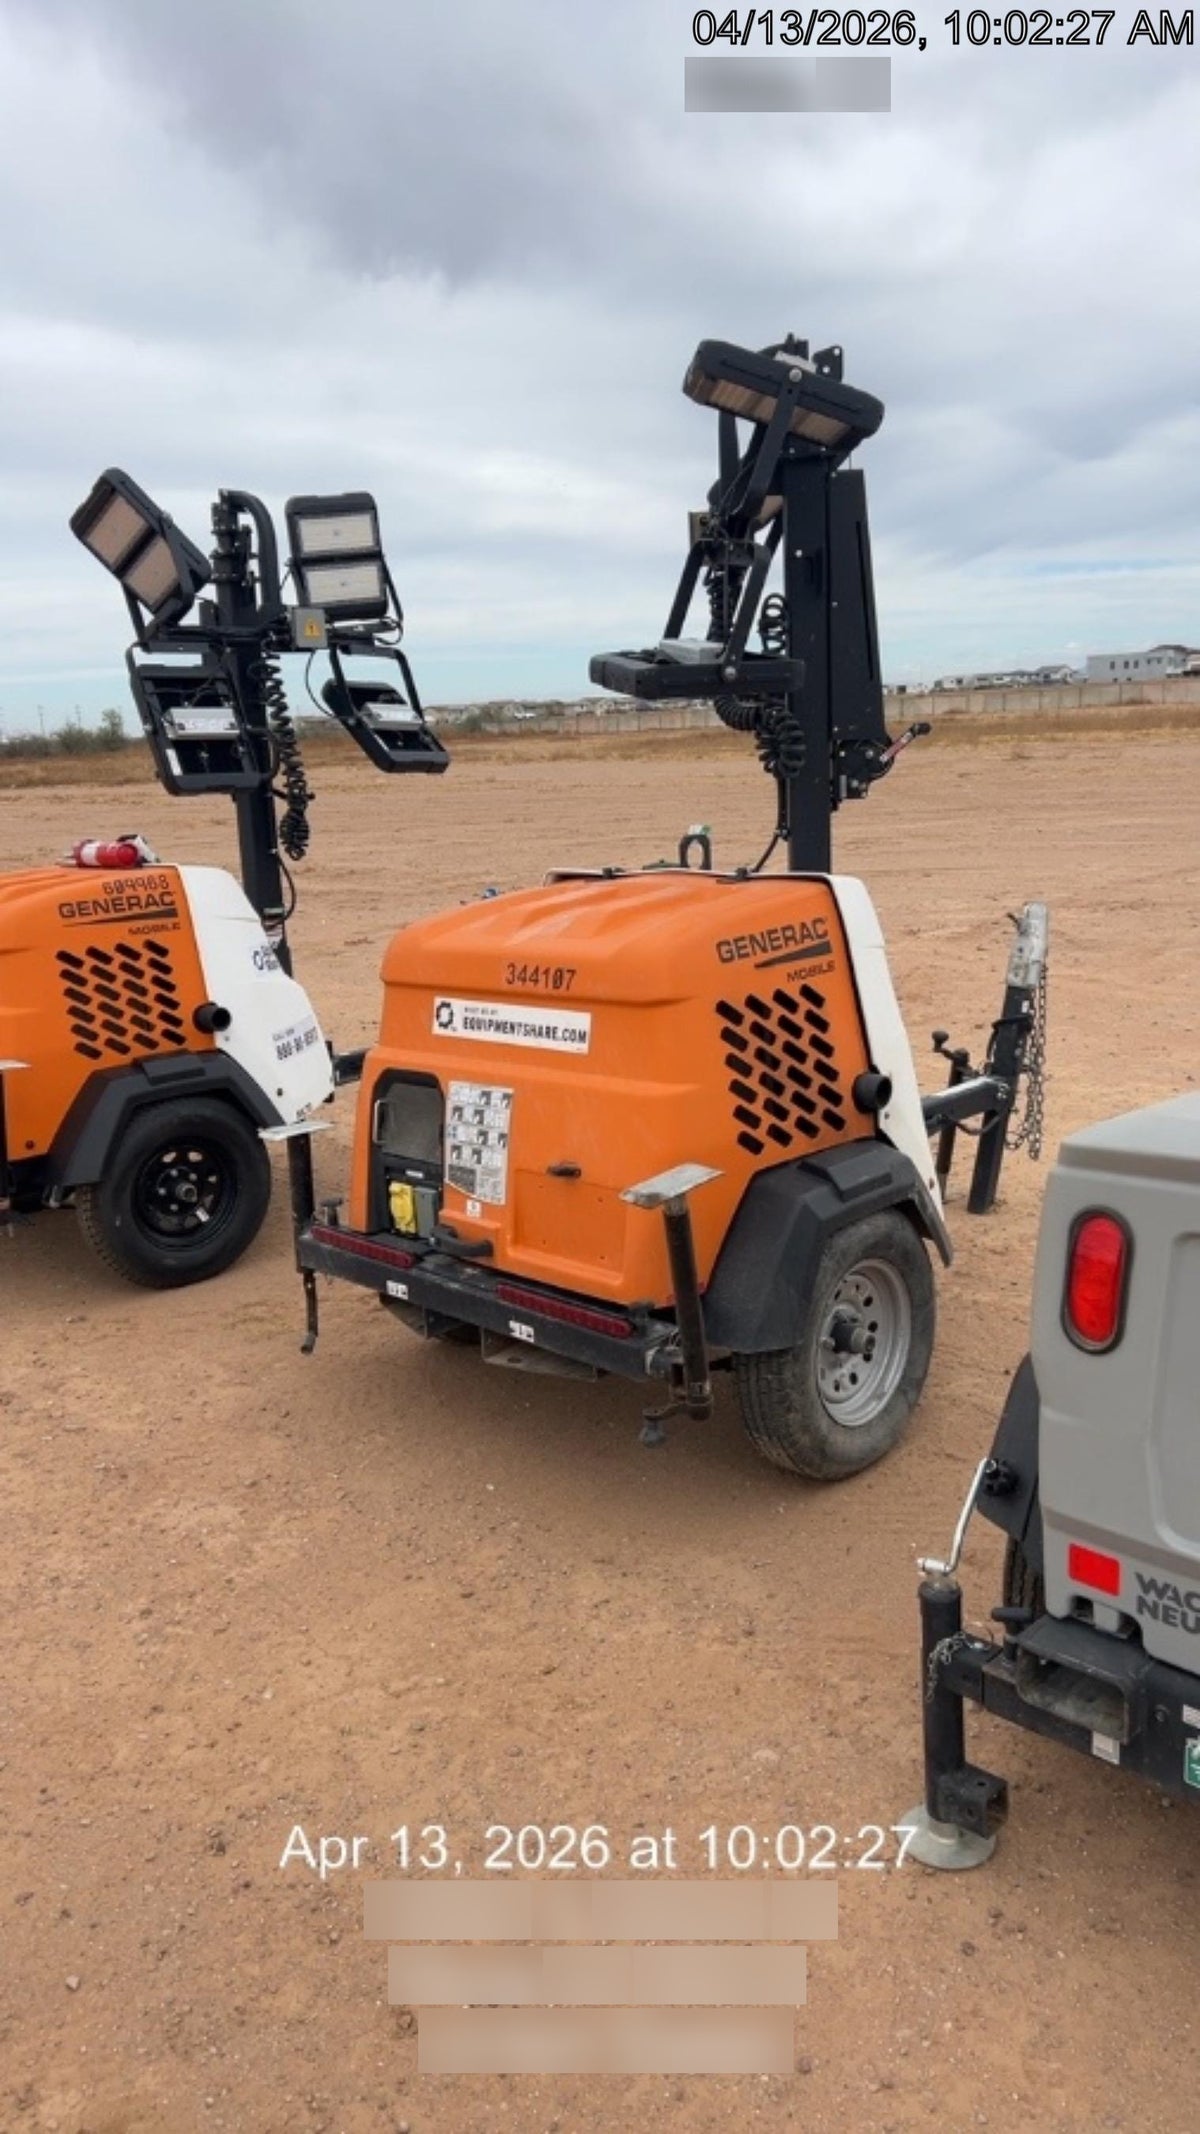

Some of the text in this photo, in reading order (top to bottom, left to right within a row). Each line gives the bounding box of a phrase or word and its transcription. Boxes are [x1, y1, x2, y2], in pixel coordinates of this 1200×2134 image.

[58, 890, 176, 919] GENERAC
[715, 917, 829, 964] GENERAC
[505, 962, 577, 991] 344107
[786, 959, 836, 983] MOBILE
[462, 1016, 587, 1044] EQUIPMENTSHARE.COM
